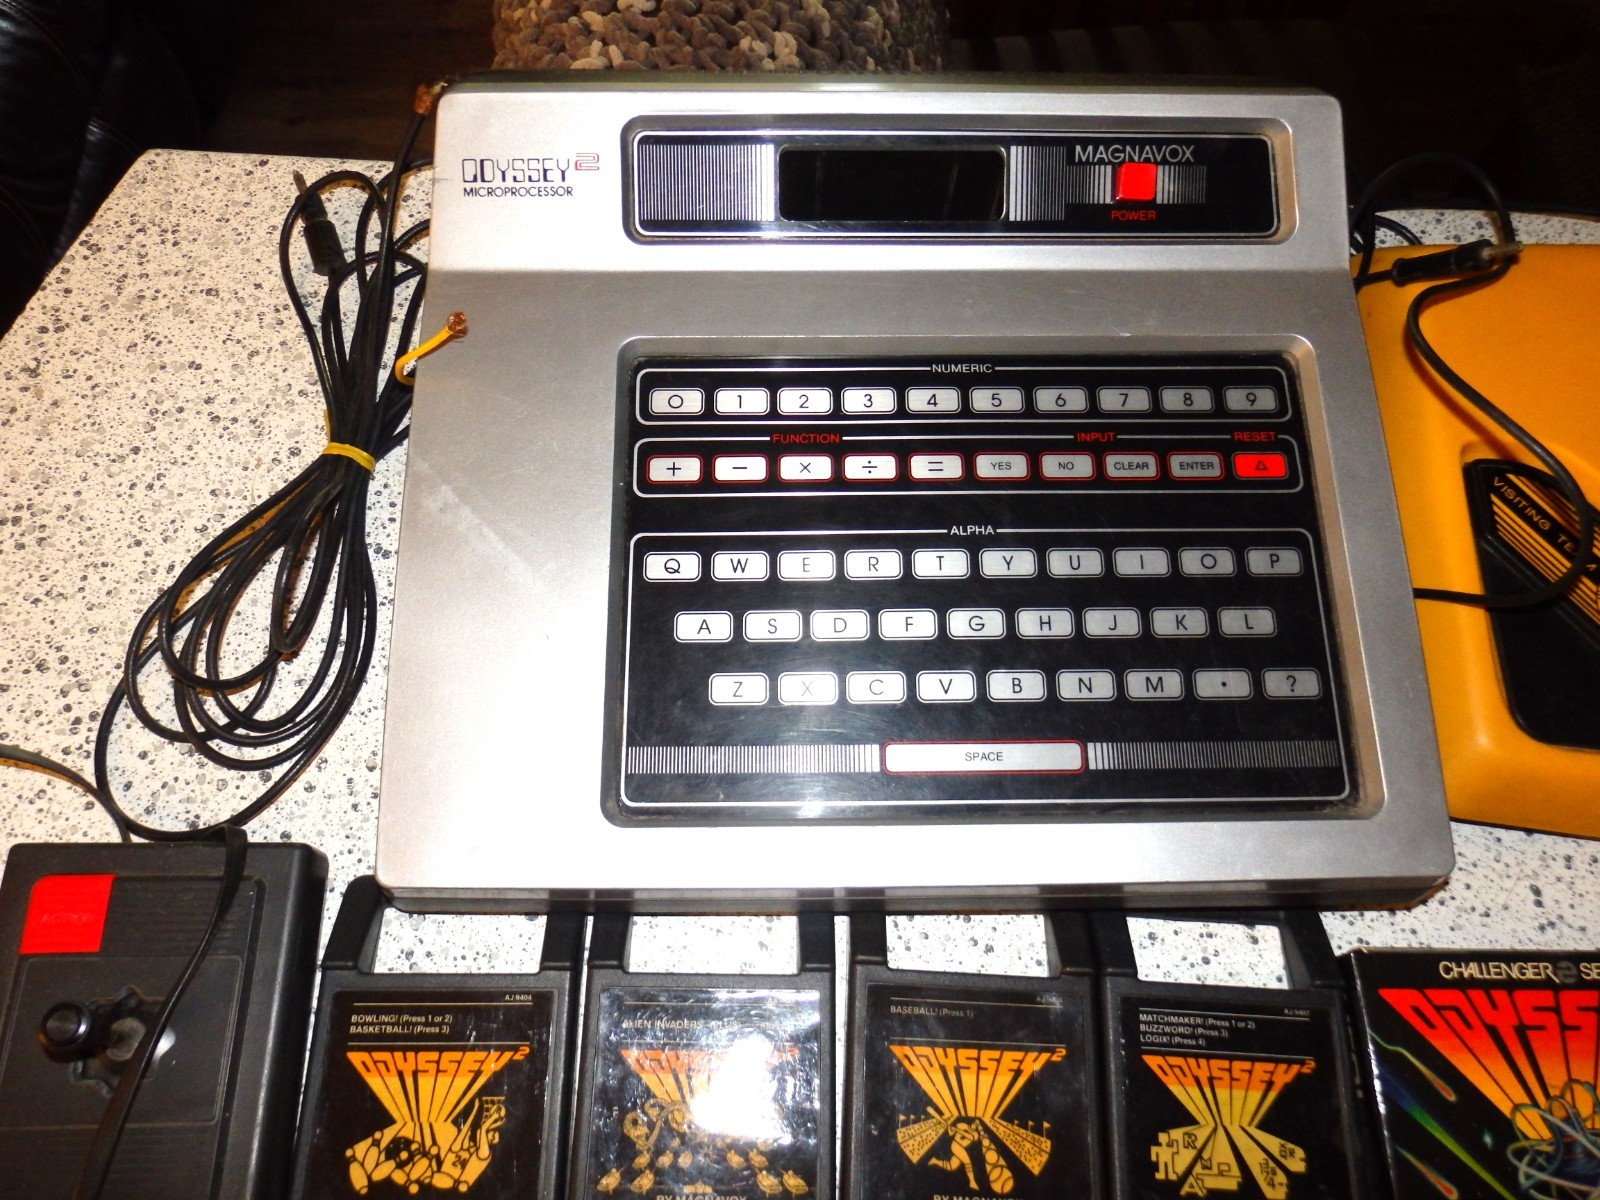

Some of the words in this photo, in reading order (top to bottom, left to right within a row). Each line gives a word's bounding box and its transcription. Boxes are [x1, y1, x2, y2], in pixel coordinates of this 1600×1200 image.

[1075, 145, 1195, 163] MAGNAVOX
[463, 186, 574, 197] MICROPROCESSOR
[1111, 210, 1157, 221] POWER
[932, 363, 992, 374] NUMERIC
[799, 394, 809, 409] 2
[863, 393, 874, 409] 3
[926, 393, 939, 408] 4
[991, 392, 1003, 408] 5
[1054, 392, 1067, 408] 6
[1118, 392, 1129, 408] 7
[1182, 392, 1194, 407] 8
[1245, 391, 1257, 407] 9
[772, 433, 840, 445] FUNCTION
[1077, 432, 1116, 443] INPUT
[1234, 432, 1276, 442] RESET
[990, 461, 1012, 471] YES
[1058, 461, 1074, 471] NO
[1113, 461, 1149, 471] CLEAR
[1179, 461, 1215, 471] ENTER
[1493, 476, 1551, 530] VISITING
[950, 525, 994, 536] ALPHA
[663, 557, 681, 575] Q
[729, 557, 749, 574] W
[802, 557, 810, 573] E
[868, 556, 879, 572] R
[935, 555, 945, 571] T
[1002, 555, 1014, 571] Y
[1068, 554, 1081, 571] U
[1200, 553, 1218, 570] O
[1269, 552, 1280, 569] P
[696, 618, 712, 635] A
[767, 618, 778, 635] S
[833, 617, 848, 633] D
[905, 616, 914, 632] F
[968, 615, 986, 632] G
[1039, 615, 1052, 632] H
[1108, 614, 1118, 631] J
[1175, 614, 1189, 631] K
[1243, 613, 1255, 630] L
[732, 681, 743, 698] Z
[801, 680, 813, 697] X
[868, 678, 884, 696] C
[938, 678, 953, 695] V
[1011, 677, 1023, 694] B
[1078, 676, 1093, 694] N
[1145, 676, 1164, 693] M
[965, 752, 1004, 762] SPACE
[1439, 961, 1560, 983] CHALLENGER
[890, 1005, 937, 1016] BASEBALL!
[351, 1015, 398, 1023] BOWLING!
[400, 1015, 425, 1023] (Press
[444, 1014, 453, 1023] 2)
[622, 1019, 651, 1029] ALIEN
[655, 1019, 701, 1029] INVADERS
[1139, 1013, 1204, 1025] MATCHMAKER!
[1205, 1018, 1230, 1027] (Press
[1247, 1020, 1256, 1029] 2)
[350, 1025, 412, 1033] BASKETBALL!
[414, 1025, 439, 1034] (Press
[441, 1025, 450, 1033] 3)
[1139, 1024, 1193, 1034] BUZZWORD!
[1194, 1029, 1219, 1037] (Press
[1220, 1029, 1229, 1038] 3)
[1140, 1034, 1170, 1043] LOGIX!
[1171, 1036, 1196, 1045] (Press
[1197, 1038, 1206, 1046] 4)
